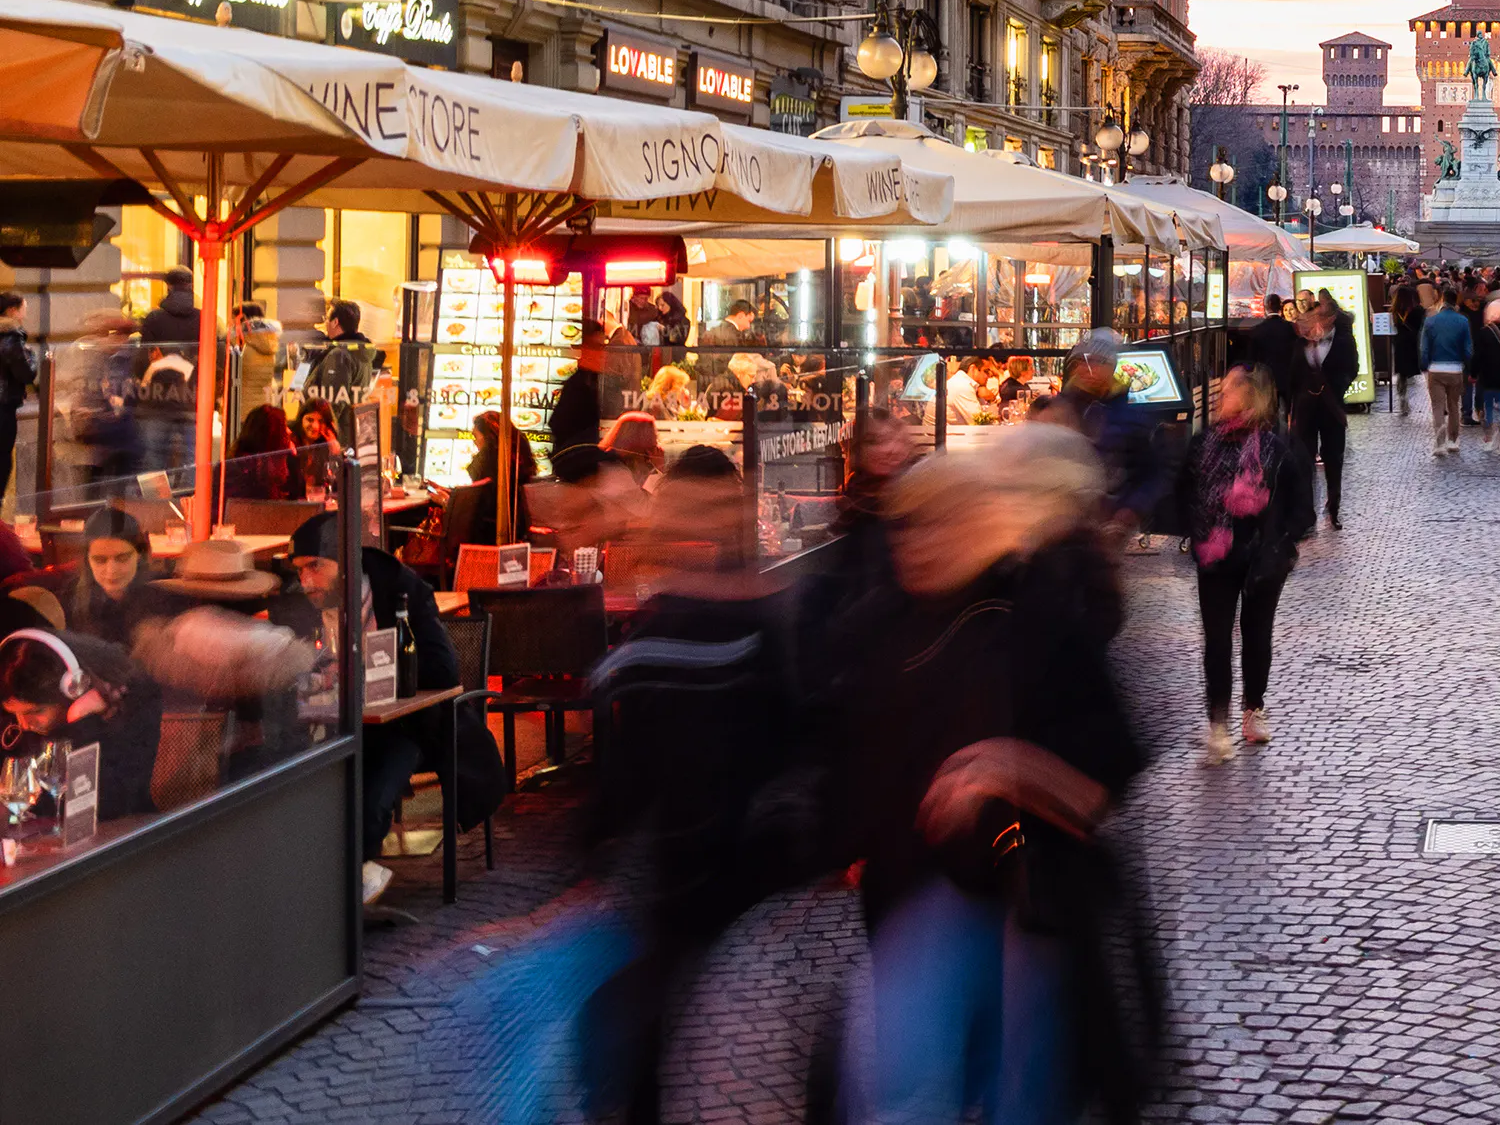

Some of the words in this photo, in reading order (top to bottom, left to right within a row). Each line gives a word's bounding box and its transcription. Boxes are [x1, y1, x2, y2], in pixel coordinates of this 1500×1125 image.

[610, 44, 674, 84] LOVABLE
[699, 66, 752, 103] LOVABLE
[866, 168, 900, 204] WINE
[760, 436, 781, 462] WINE
[782, 430, 806, 457] STORE
[806, 430, 812, 452] &
[813, 421, 854, 449] RESTAURANT
